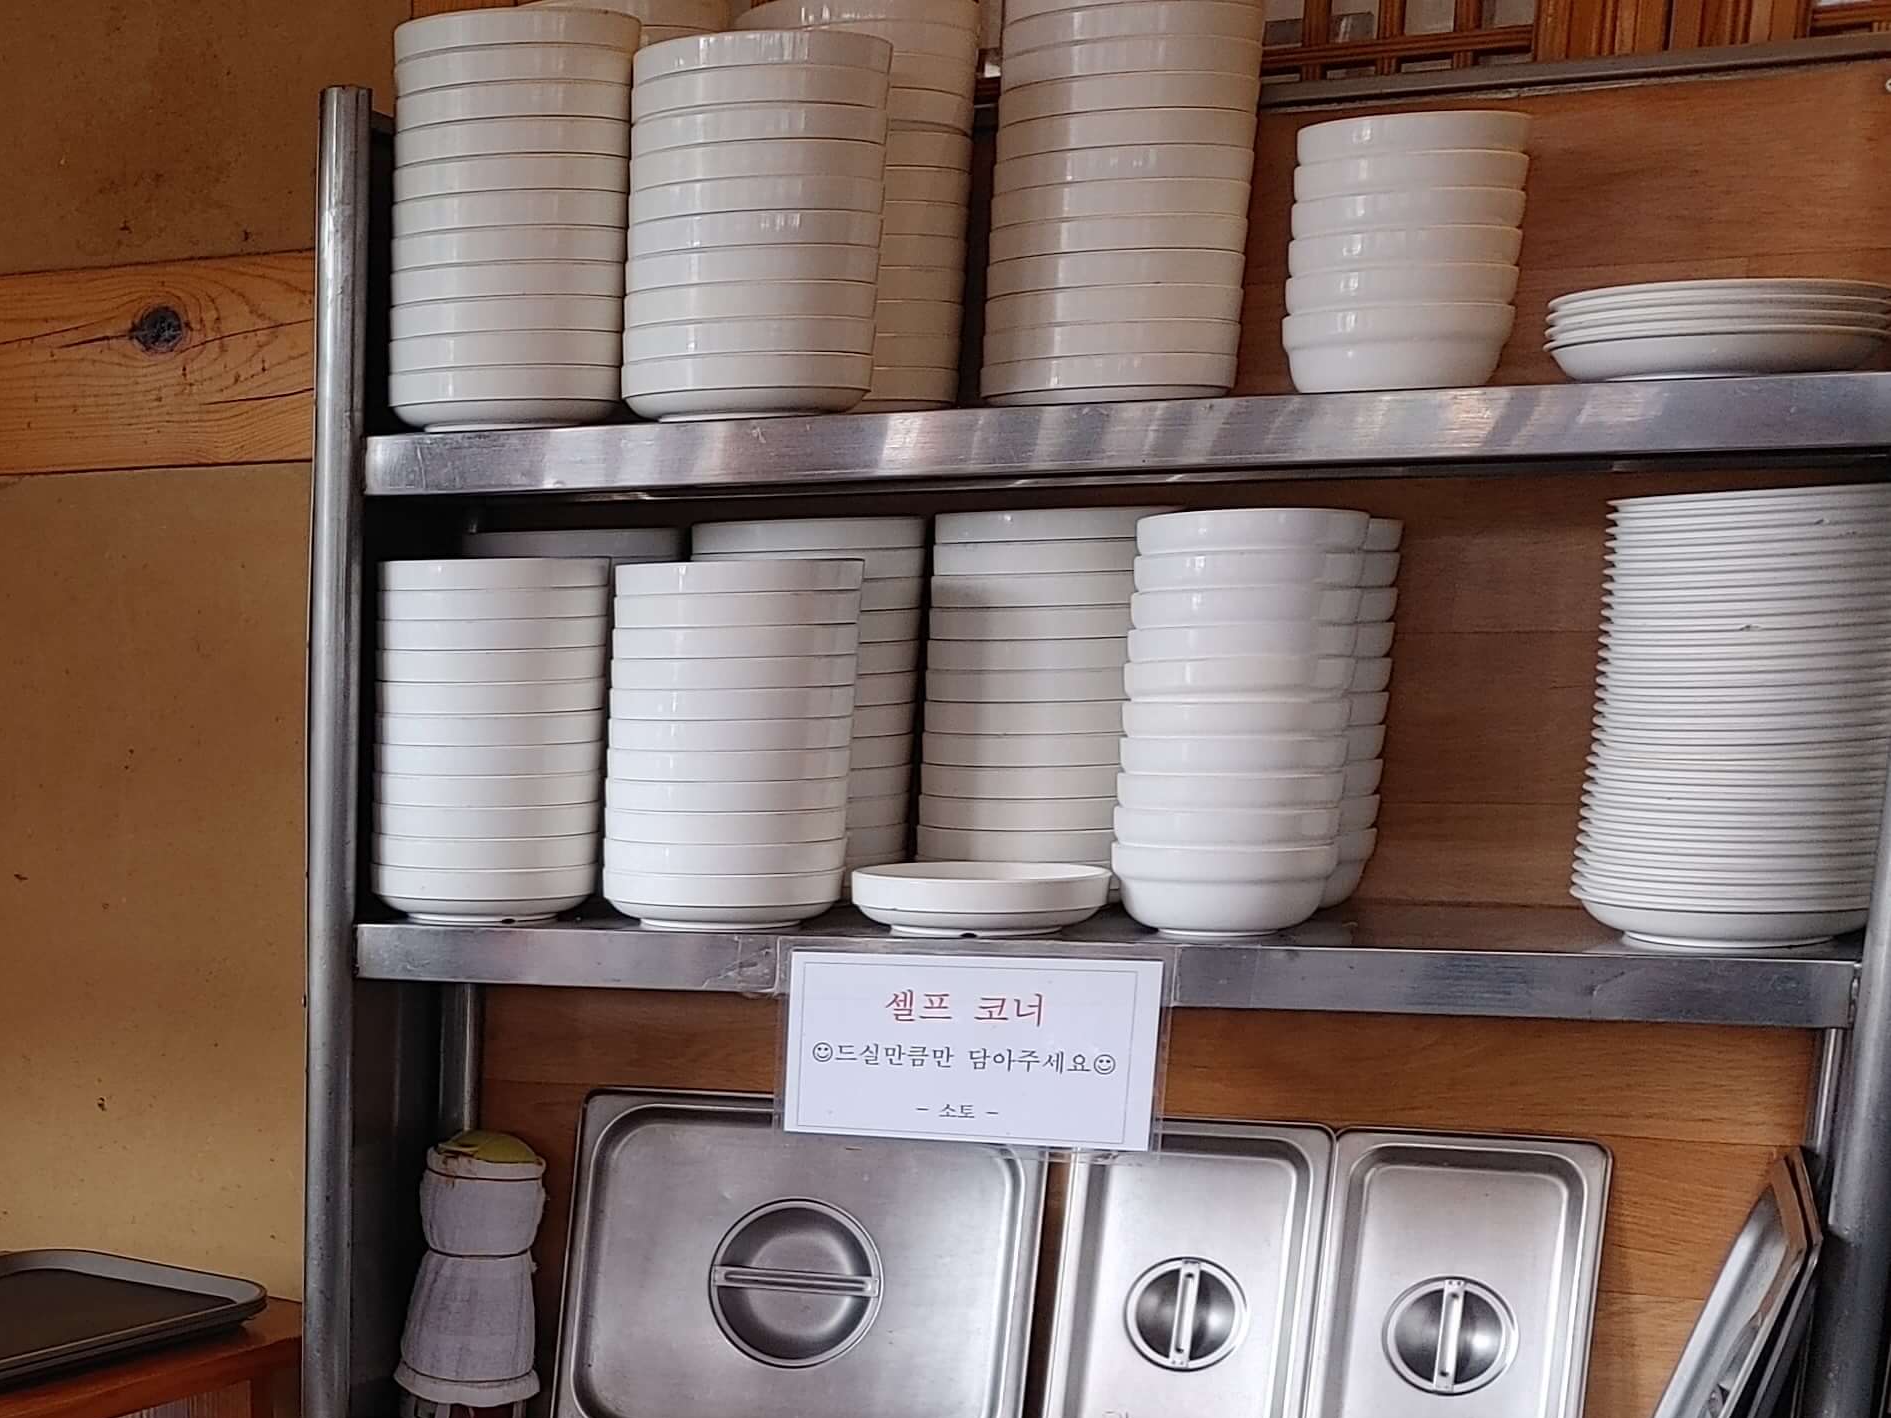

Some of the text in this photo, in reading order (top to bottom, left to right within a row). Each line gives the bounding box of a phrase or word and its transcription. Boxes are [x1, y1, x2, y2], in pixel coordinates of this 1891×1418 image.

[886, 988, 1044, 1027] 셀프 코너
[835, 1043, 1091, 1075] 드실만큼만 담아주세요
